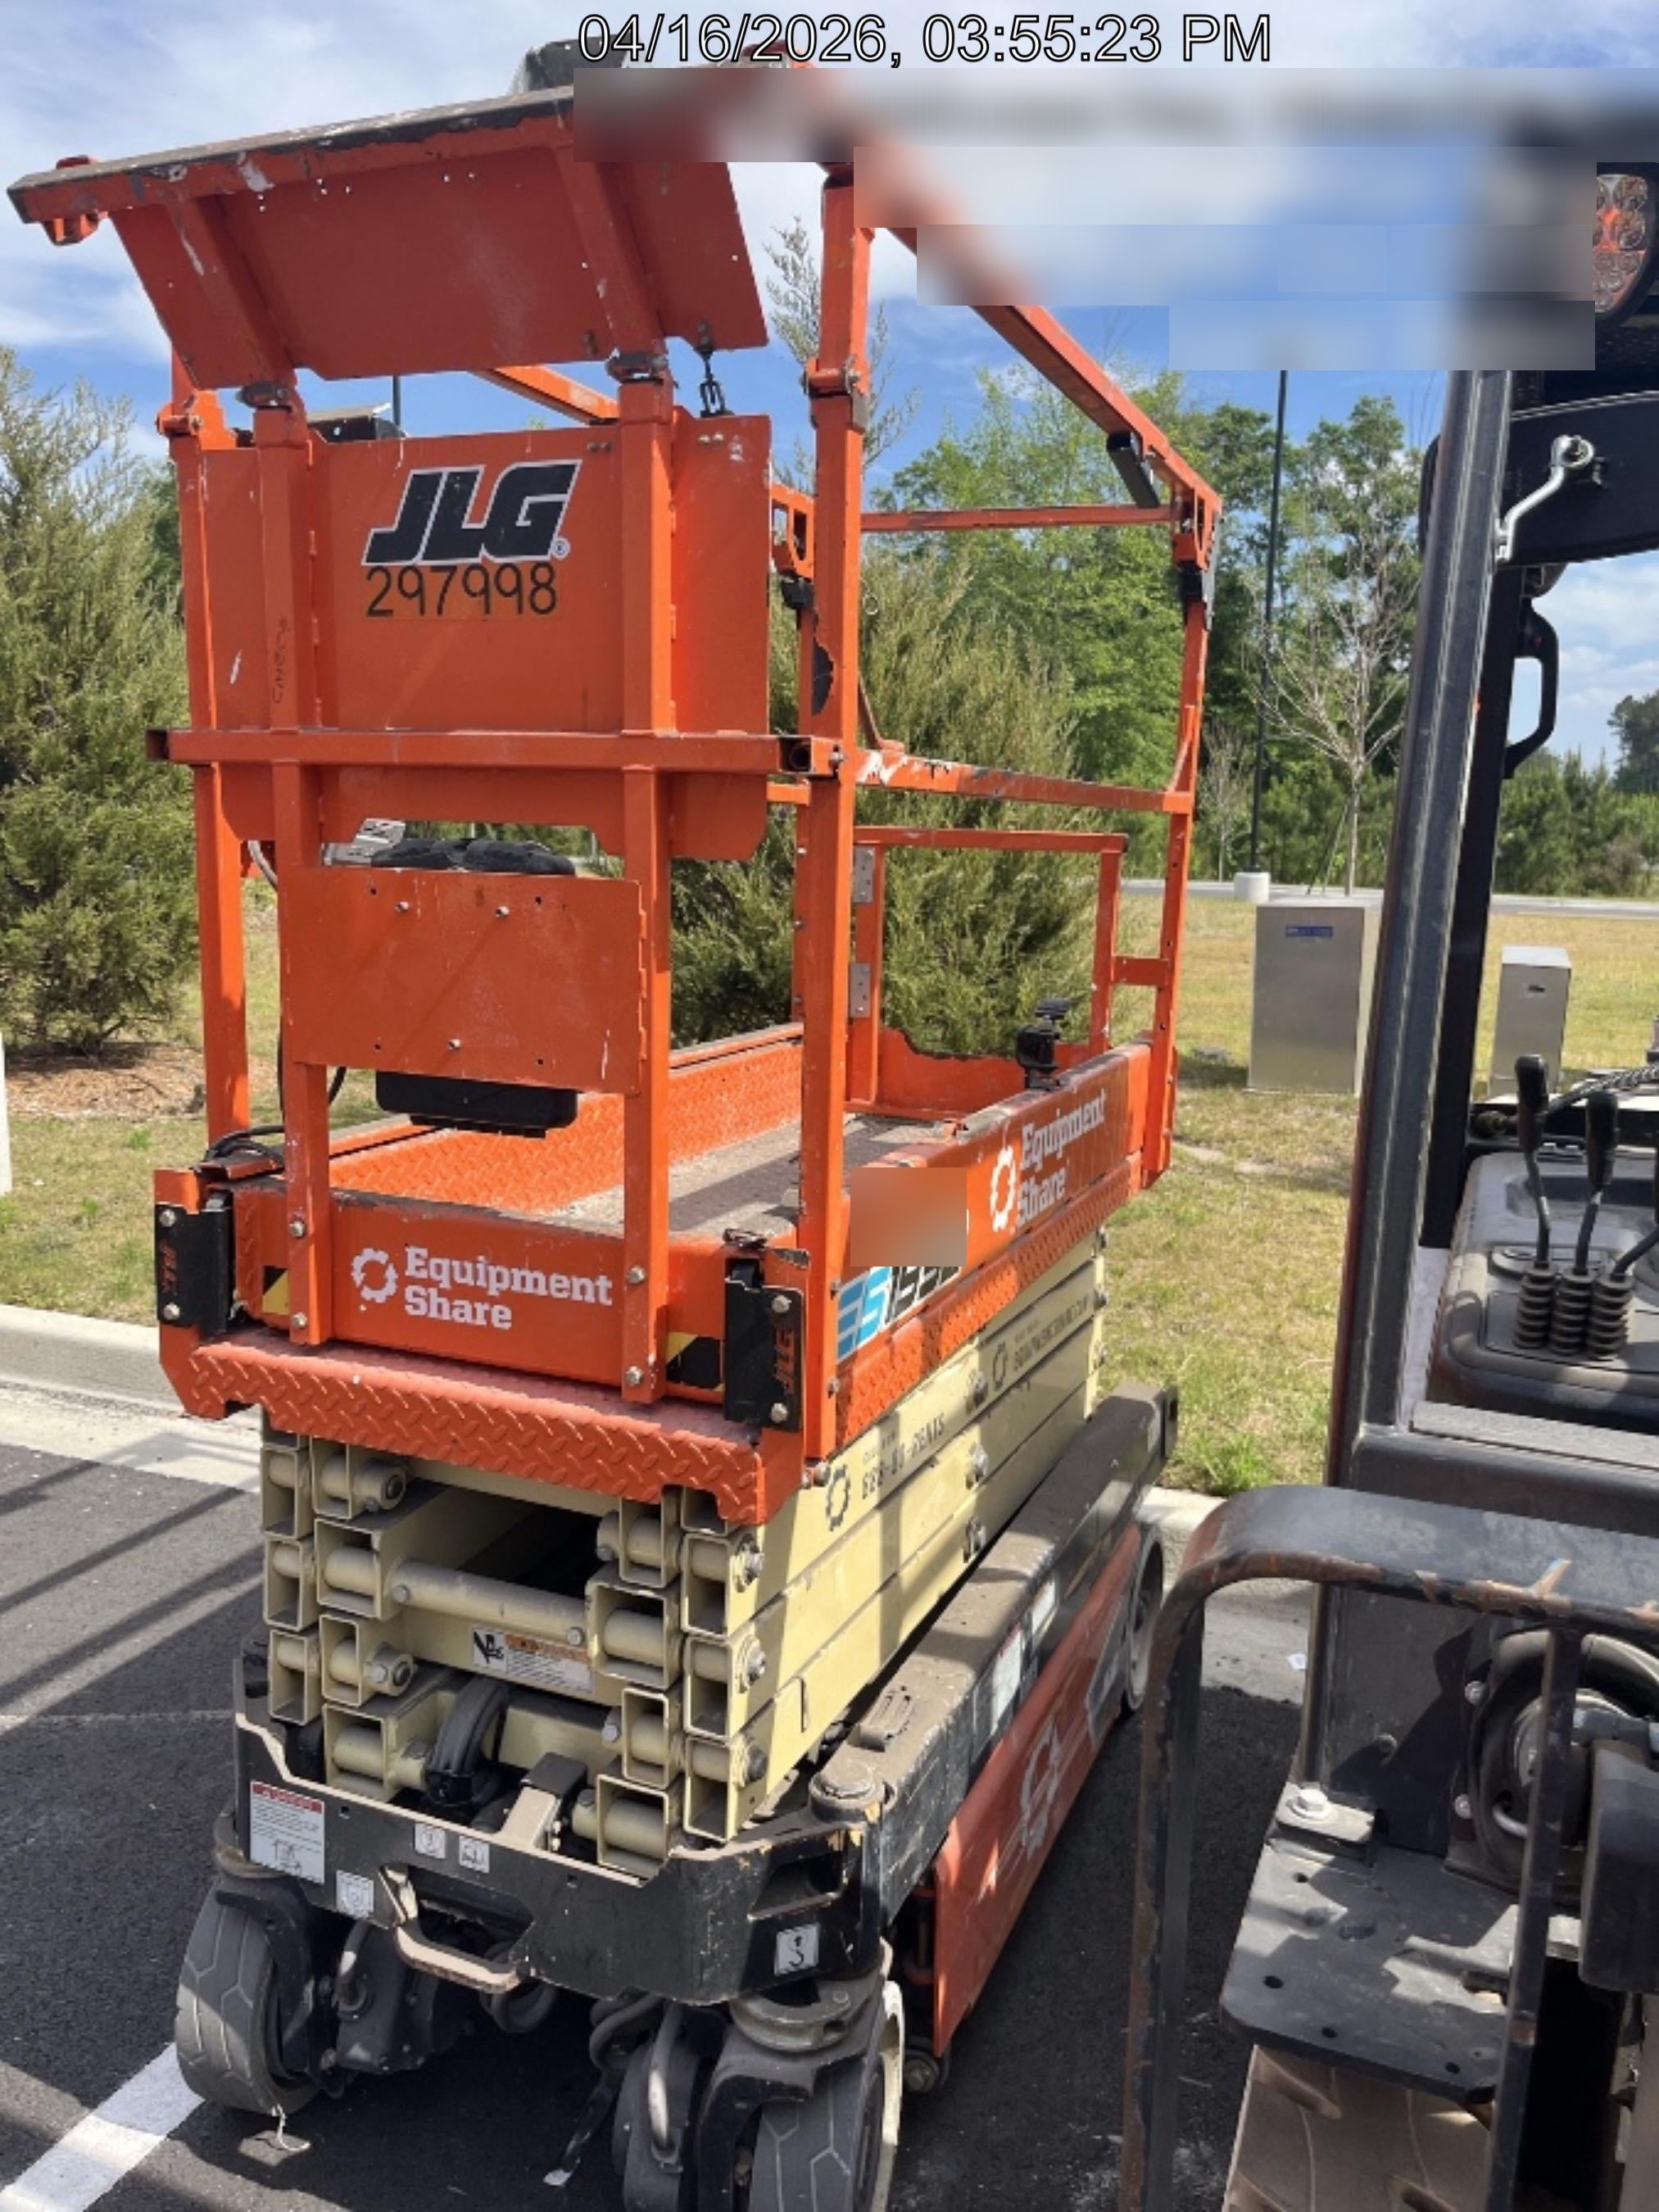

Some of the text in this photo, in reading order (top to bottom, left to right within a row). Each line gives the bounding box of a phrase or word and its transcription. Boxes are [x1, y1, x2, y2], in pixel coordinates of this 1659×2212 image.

[361, 460, 582, 566] JLG
[365, 562, 557, 617] 297998
[1022, 1088, 1108, 1172] Equipment
[1018, 1167, 1067, 1227] Share
[405, 1244, 613, 1306] Equipment
[405, 1285, 513, 1331] Share
